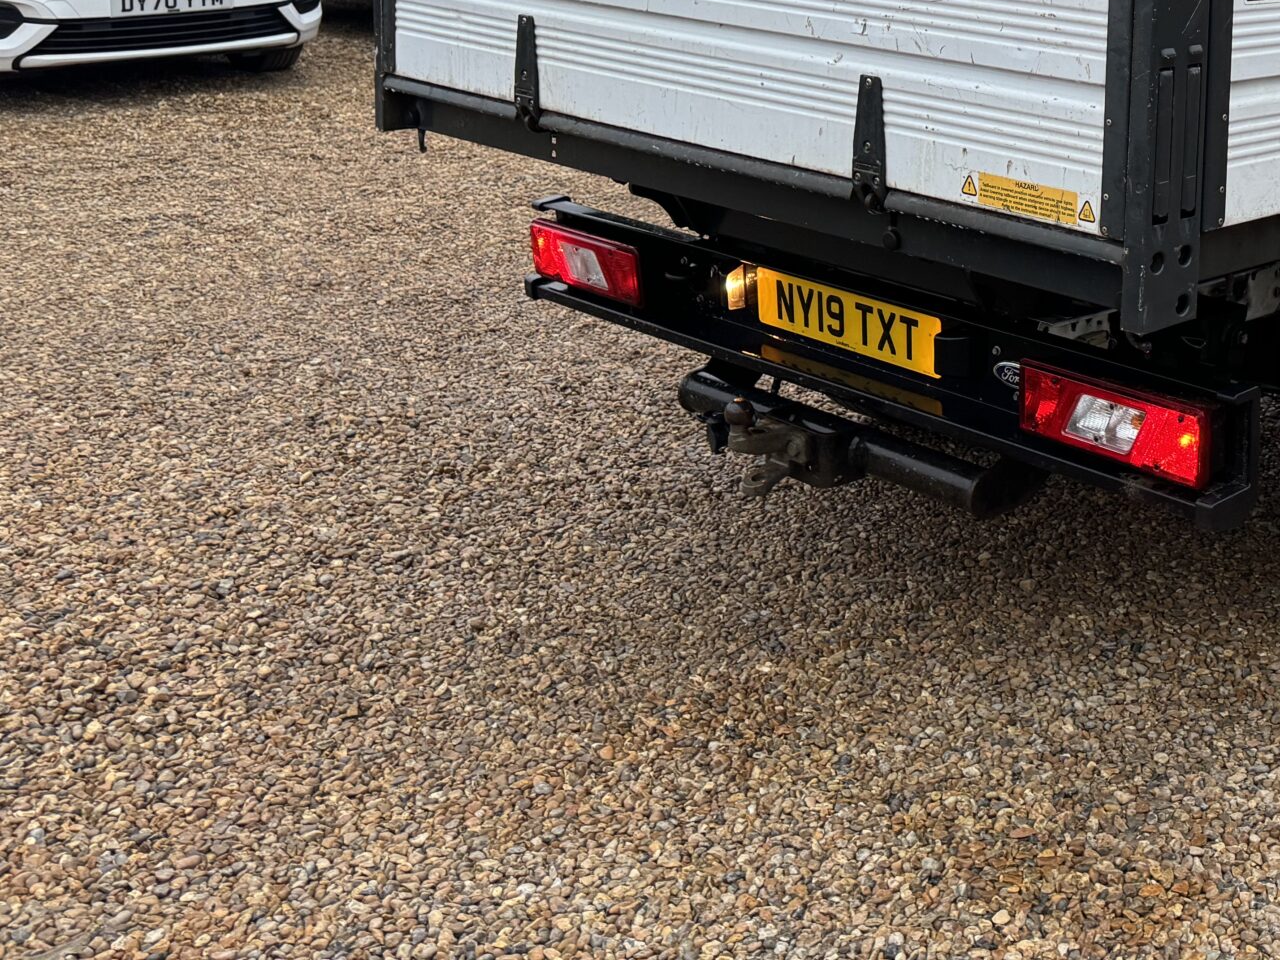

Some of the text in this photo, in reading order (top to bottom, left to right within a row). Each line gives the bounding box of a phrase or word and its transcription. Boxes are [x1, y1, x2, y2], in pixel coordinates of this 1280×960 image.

[1015, 181, 1040, 191] HAZARD
[775, 279, 919, 361] NY19 TXT
[1001, 366, 1021, 384] For
